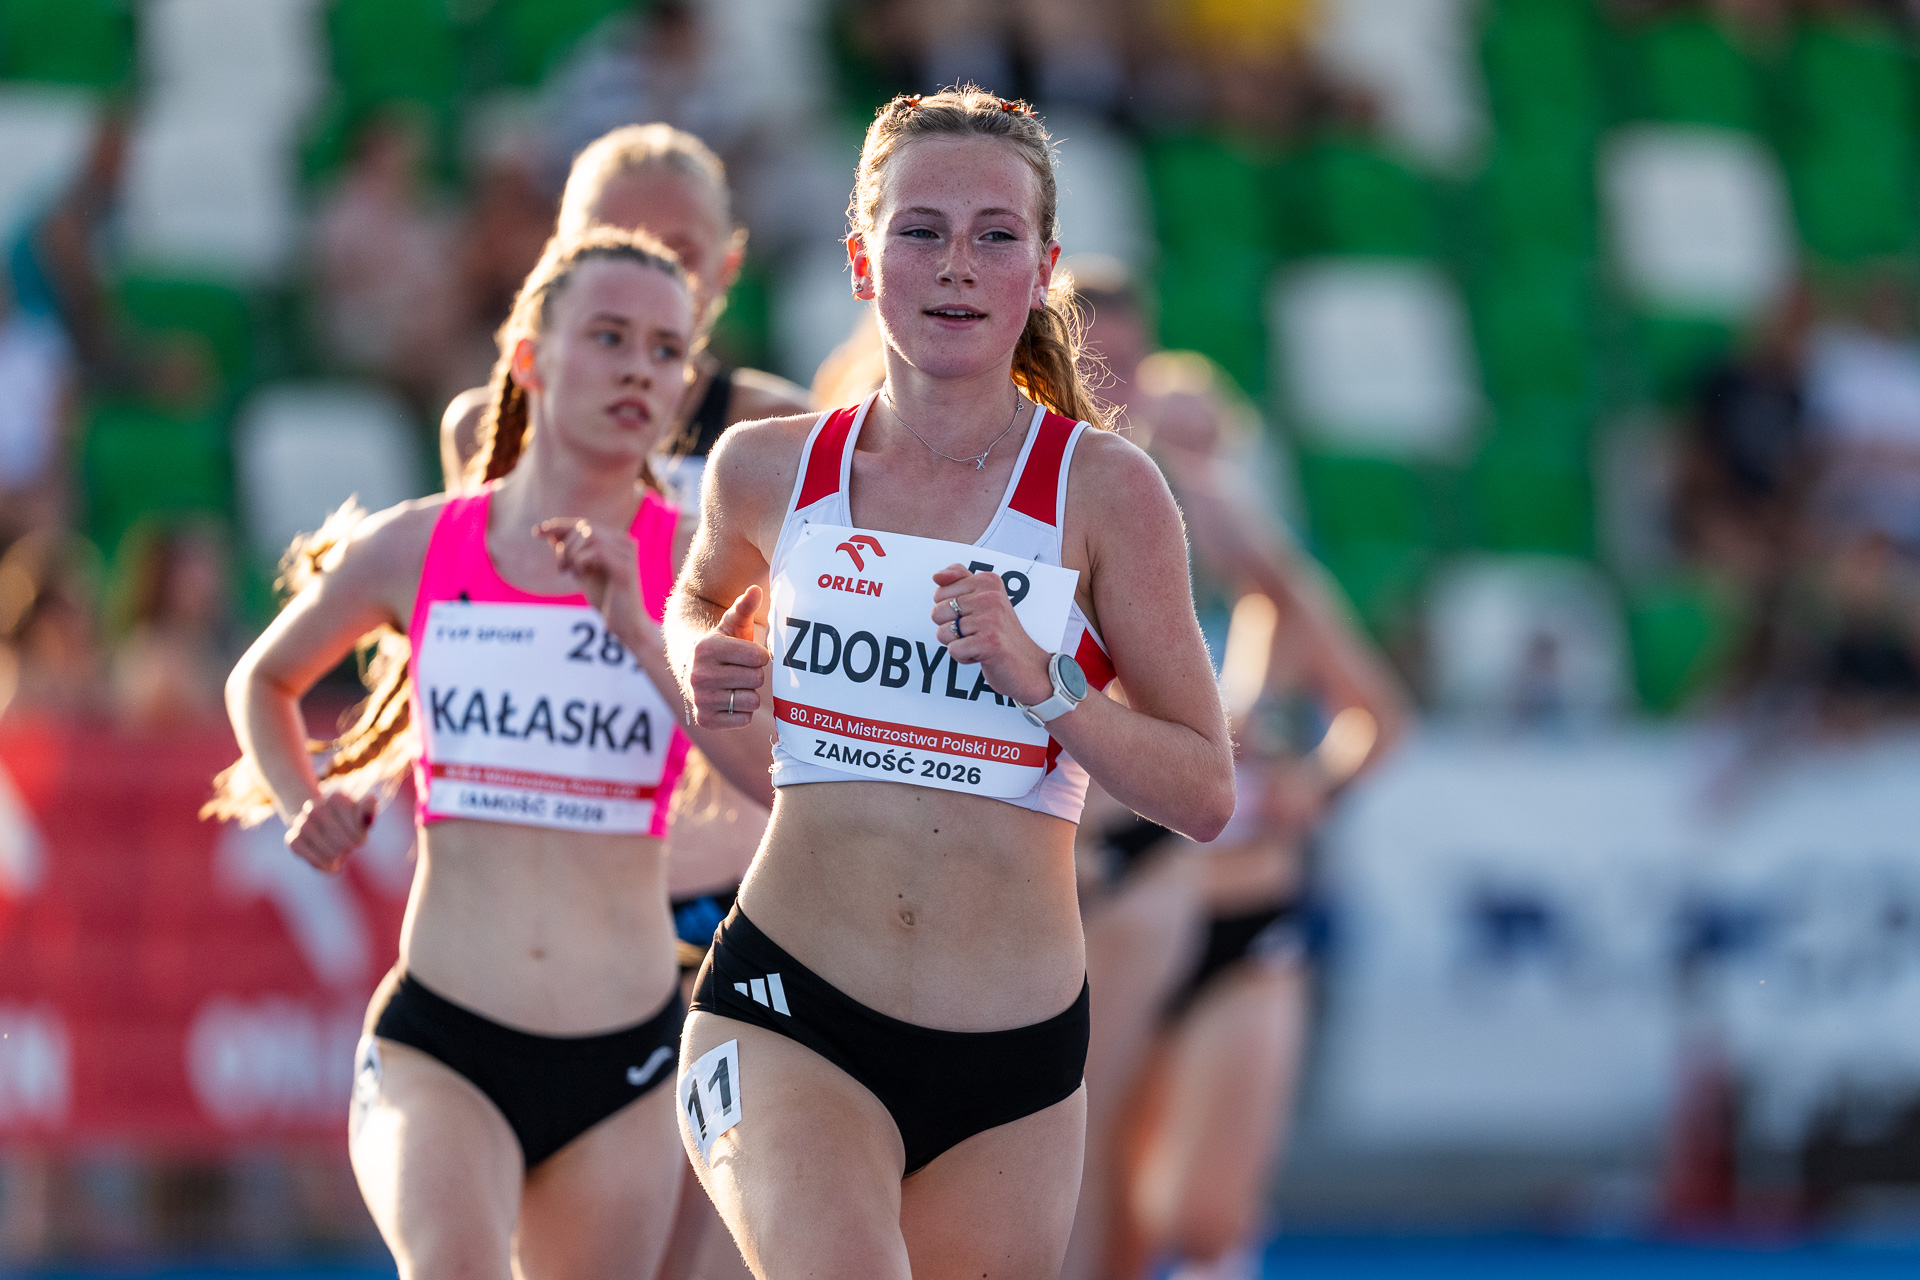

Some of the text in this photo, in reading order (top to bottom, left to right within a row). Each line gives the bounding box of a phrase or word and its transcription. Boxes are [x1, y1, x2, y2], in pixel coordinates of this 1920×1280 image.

[818, 573, 883, 597] ORLEN
[967, 560, 1030, 608] 9
[567, 621, 645, 673] 28
[783, 616, 1016, 708] ZDOBYLA
[430, 686, 653, 754] KAŁASKA
[789, 707, 1021, 761] 80. PZLA Mistrzostwa Polski U20
[813, 739, 982, 785] ZAMOŚĆ 2026
[687, 1056, 732, 1141] 11
